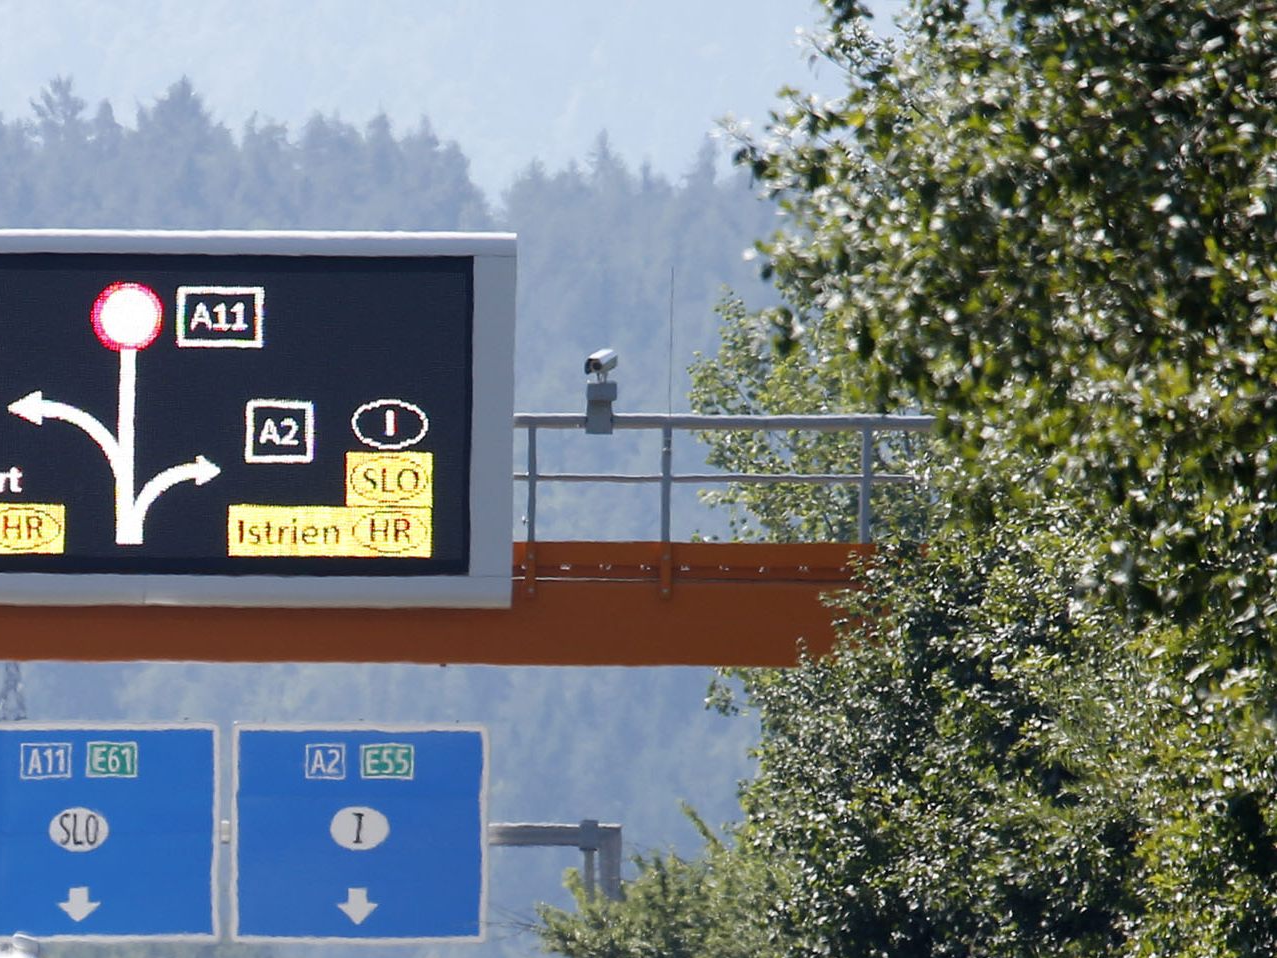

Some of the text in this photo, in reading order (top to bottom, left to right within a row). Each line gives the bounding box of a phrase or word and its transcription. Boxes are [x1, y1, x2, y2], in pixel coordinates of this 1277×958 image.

[189, 302, 249, 331] A11
[259, 418, 299, 446] A2
[383, 409, 397, 437] I
[362, 468, 420, 493] SLO
[1, 515, 43, 540] HR
[237, 518, 411, 545] Istrien HR
[27, 747, 131, 775] A11 E61
[310, 748, 410, 774] A2 E55
[59, 813, 99, 845] SLO
[352, 812, 364, 844] I
